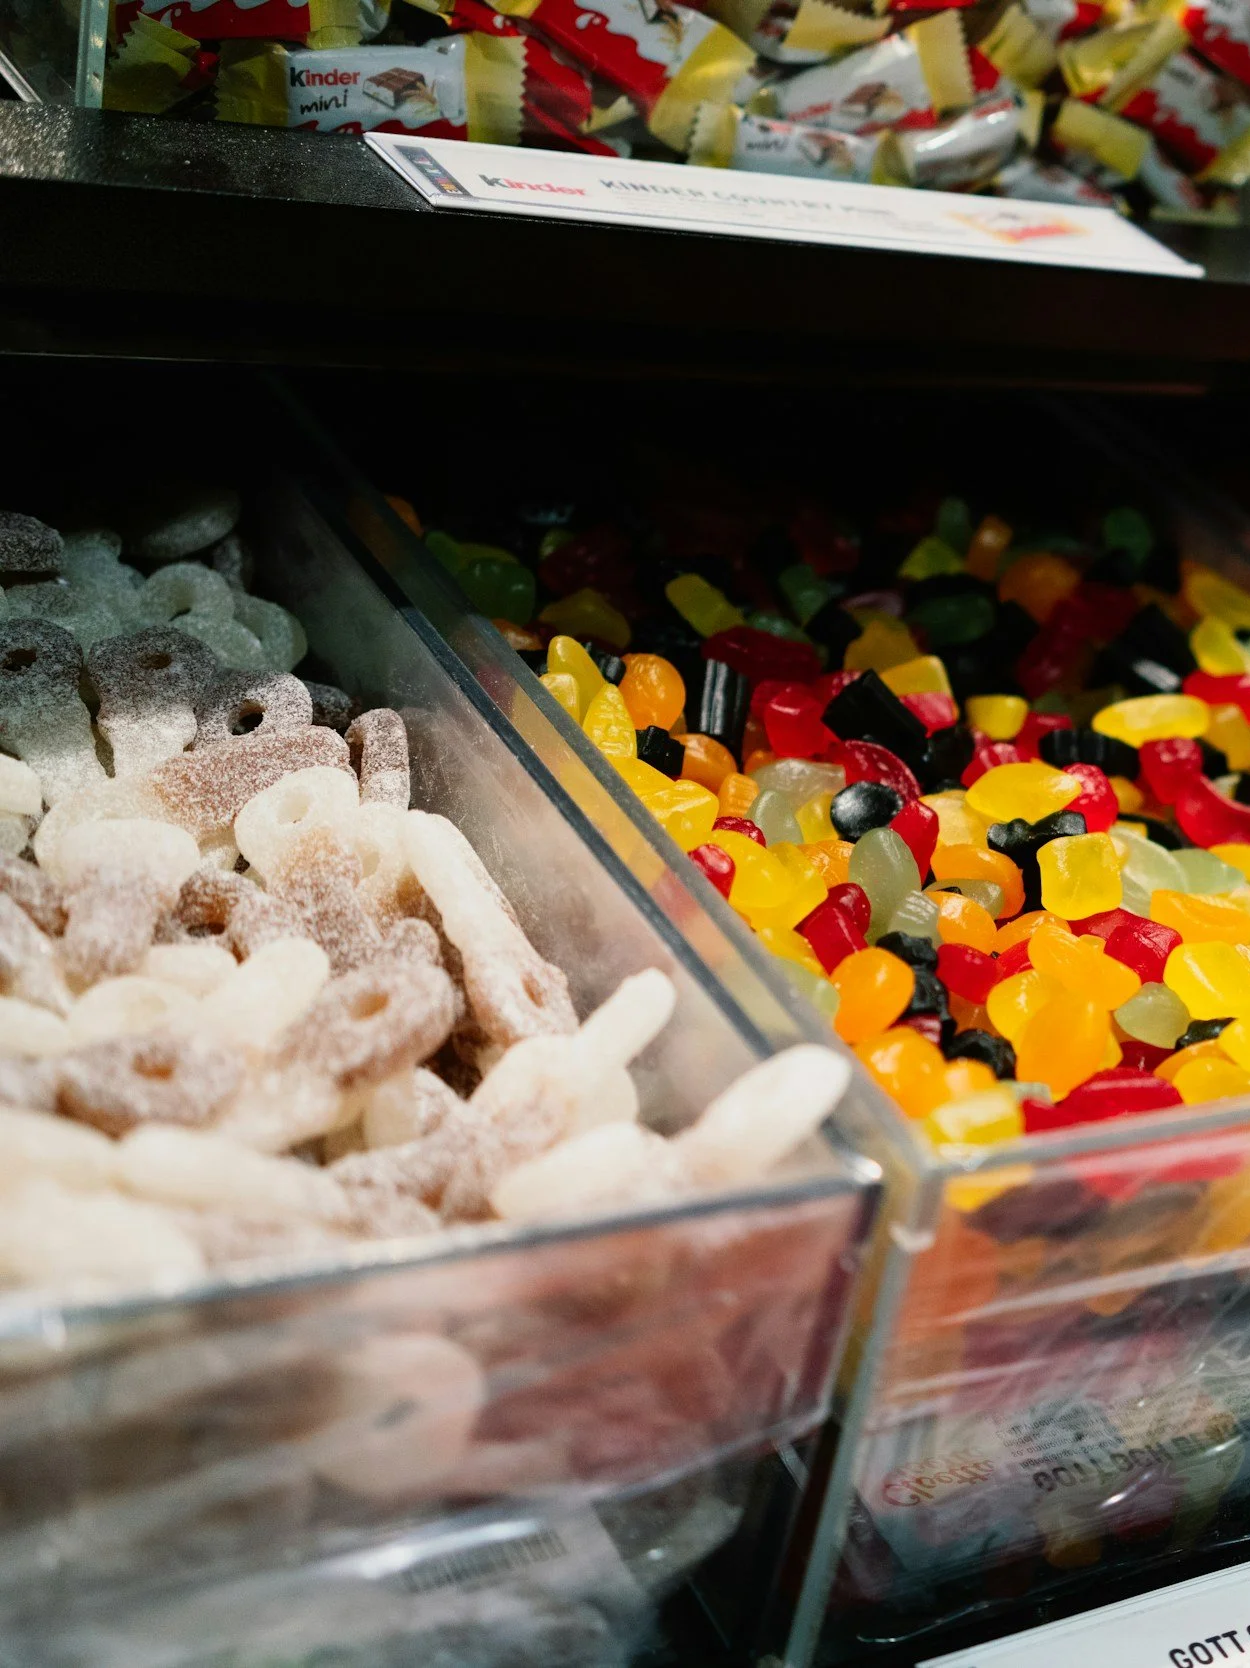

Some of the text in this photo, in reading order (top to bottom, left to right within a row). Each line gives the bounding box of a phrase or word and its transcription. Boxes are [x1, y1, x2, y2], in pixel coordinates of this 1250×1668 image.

[300, 89, 349, 115] mini
[600, 178, 704, 198] KINDER
[1168, 1630, 1245, 1668] GOTT
